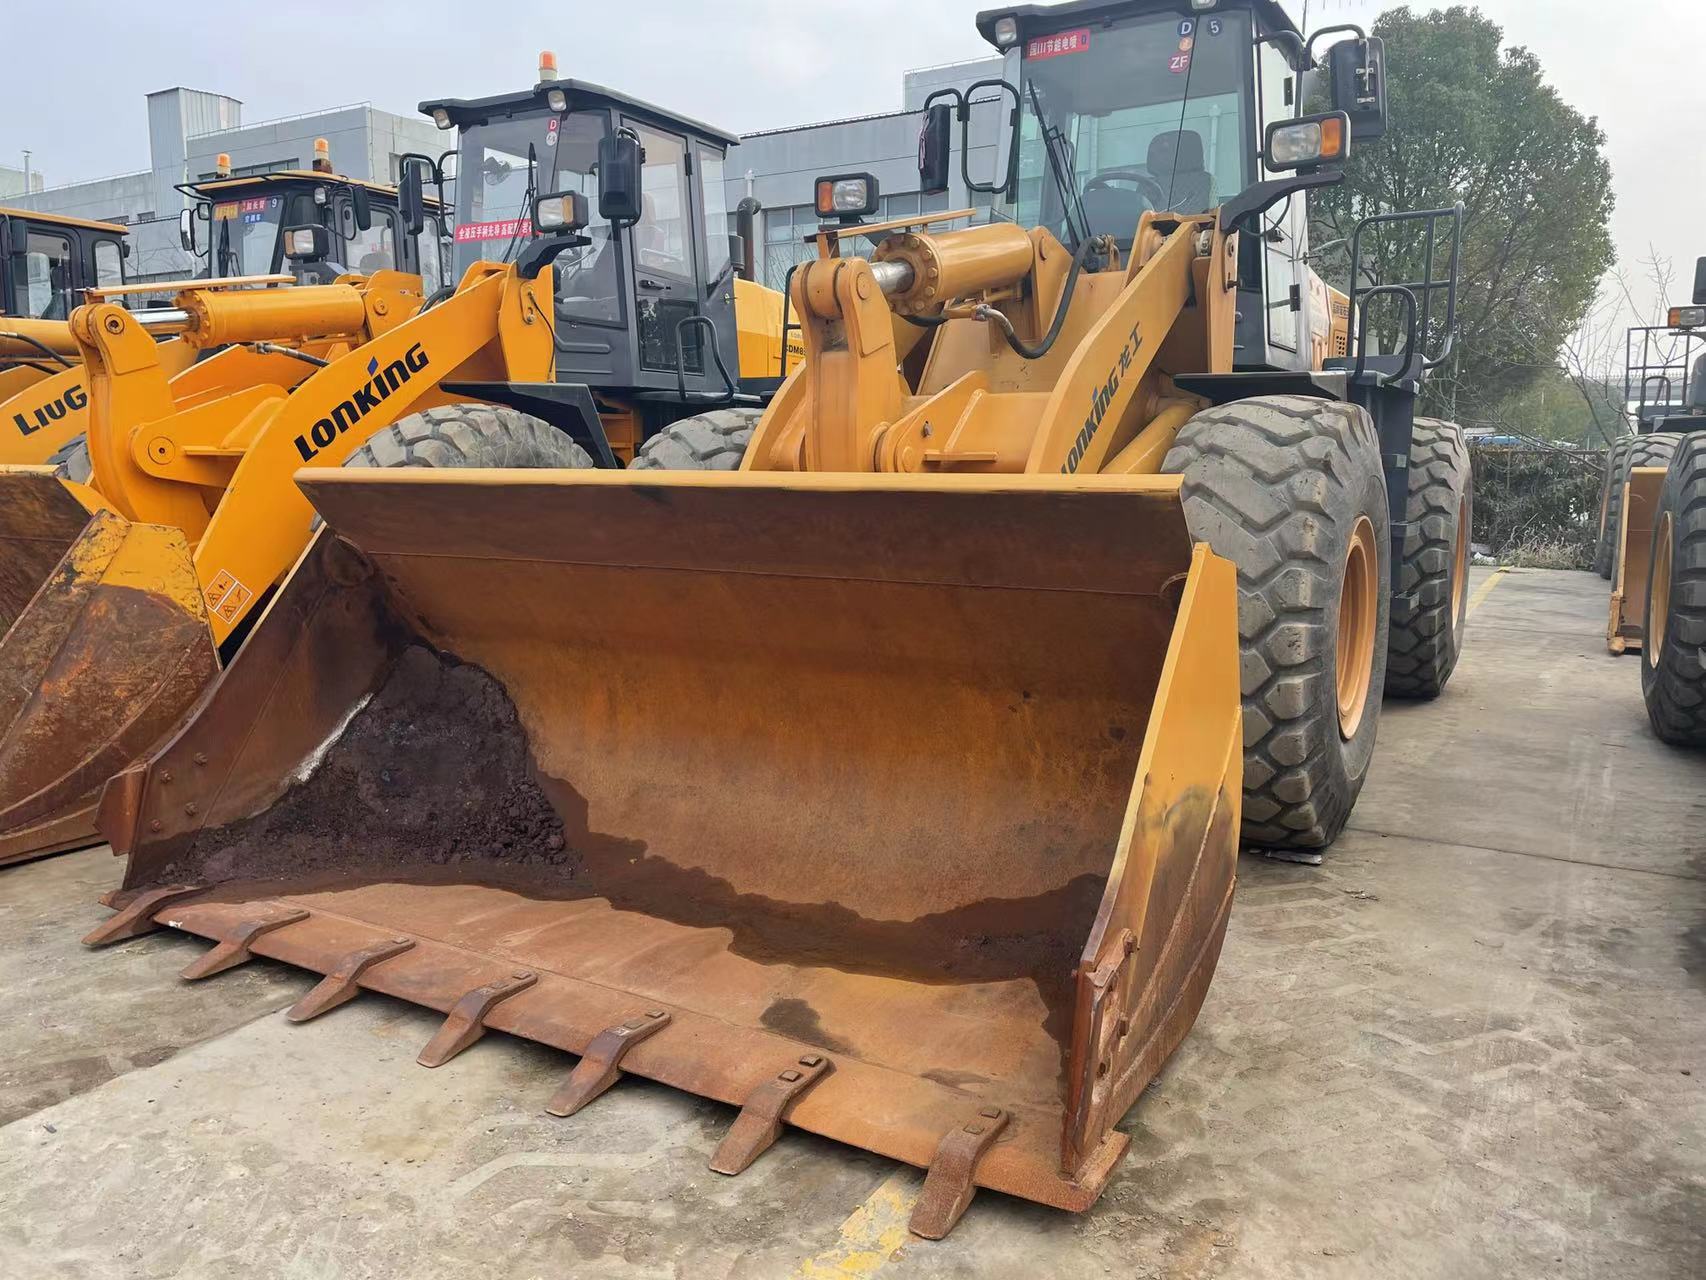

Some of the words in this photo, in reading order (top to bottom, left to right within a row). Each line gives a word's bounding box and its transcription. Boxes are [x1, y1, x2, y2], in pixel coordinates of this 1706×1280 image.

[1181, 22, 1192, 34] D
[1210, 21, 1219, 33] 5
[1170, 55, 1188, 69] ZF
[271, 198, 278, 208] 9
[294, 342, 430, 463] LONKING
[1061, 365, 1120, 474] ONKING
